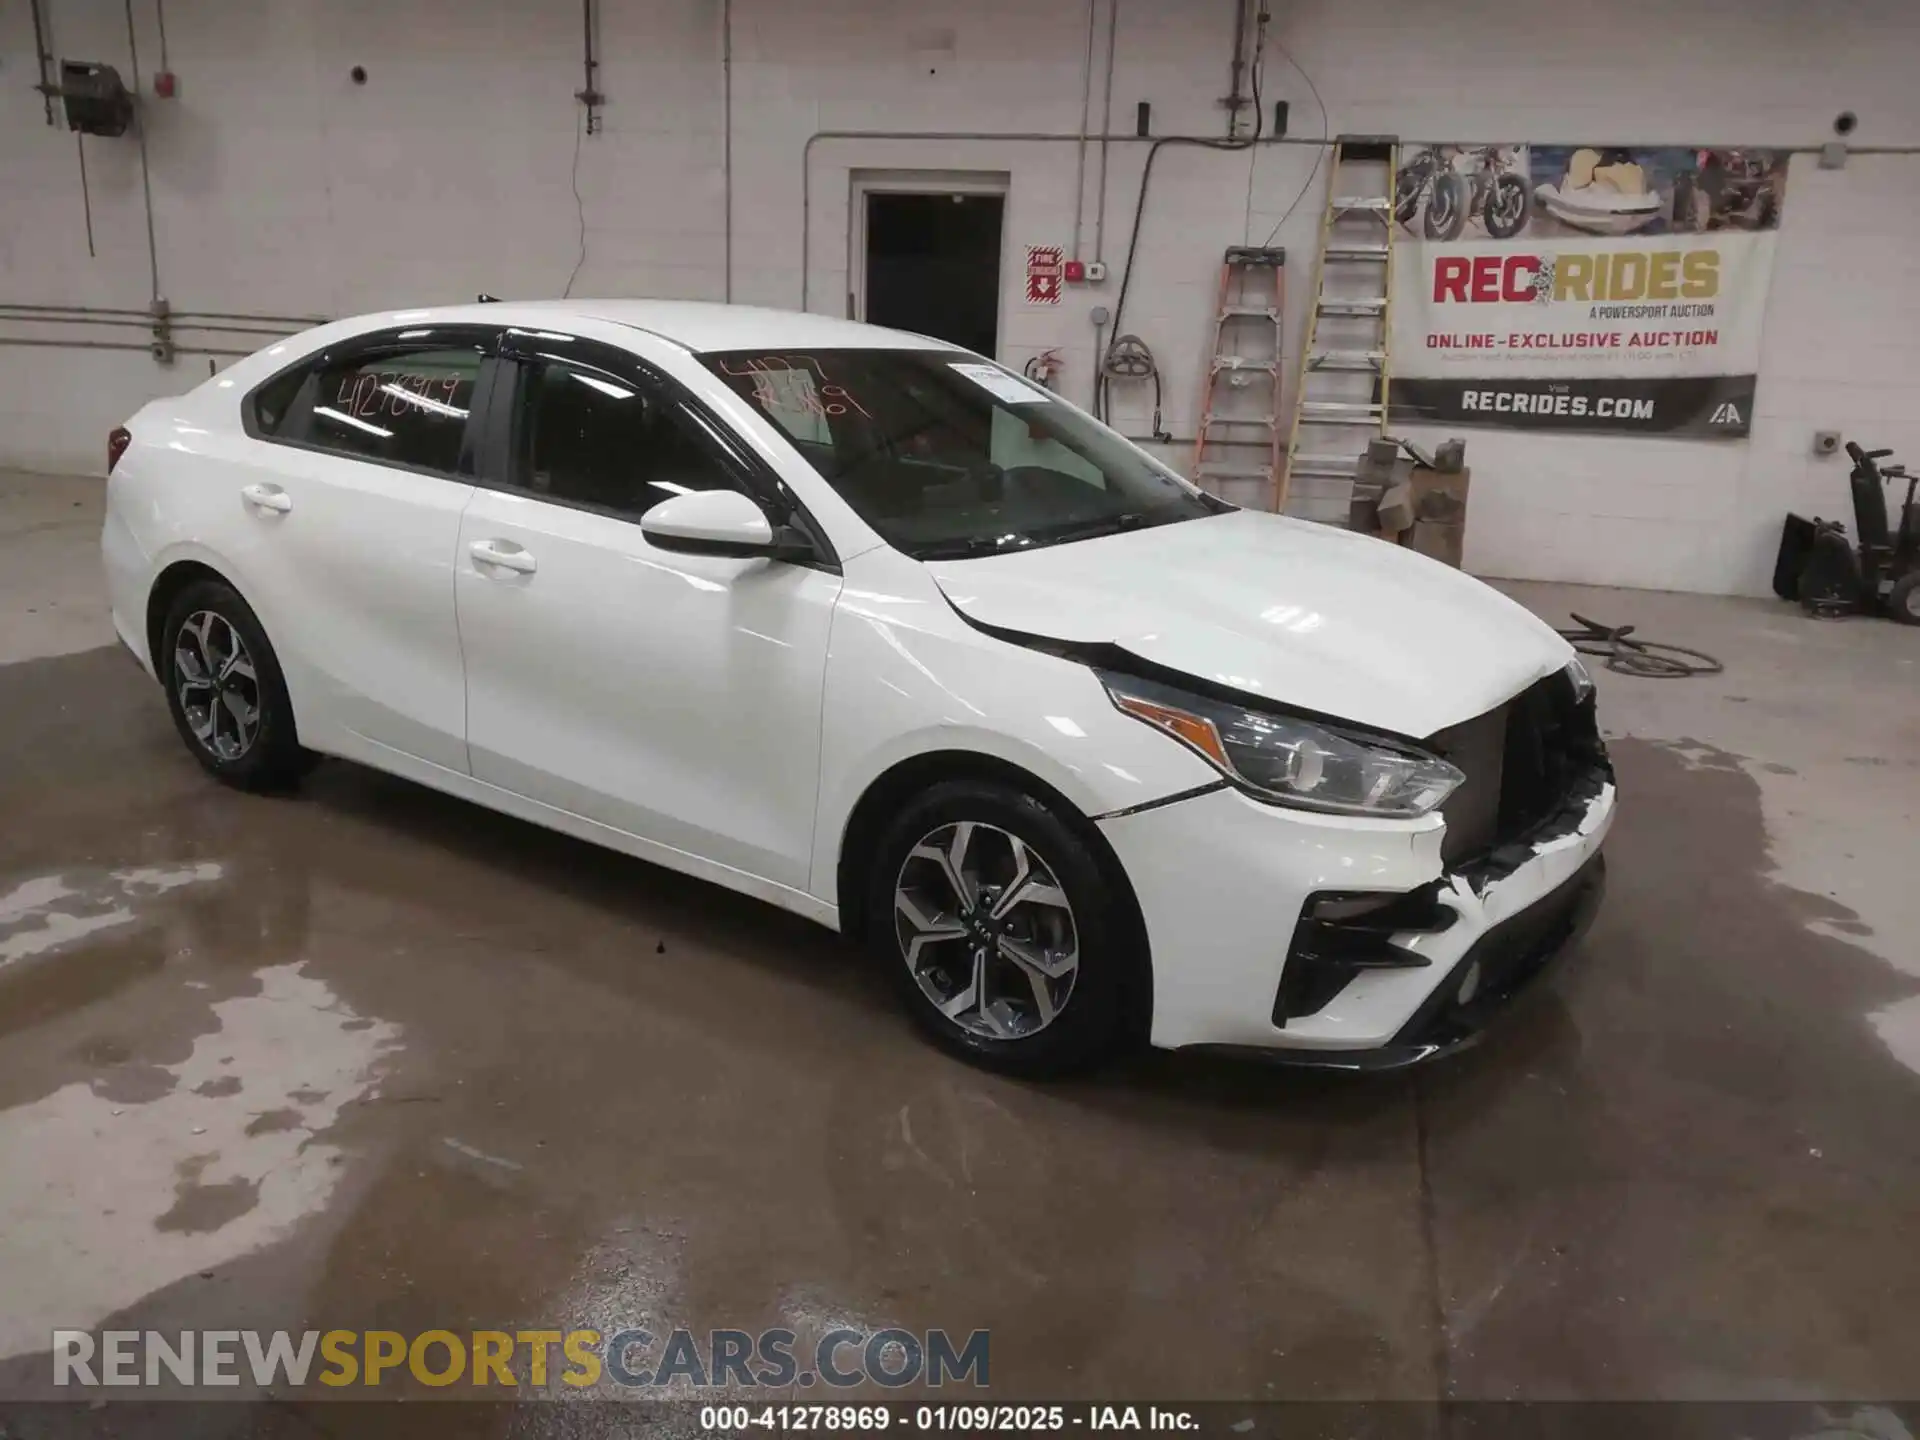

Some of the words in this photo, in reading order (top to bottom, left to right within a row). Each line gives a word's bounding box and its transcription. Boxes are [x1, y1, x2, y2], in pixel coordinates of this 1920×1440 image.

[1433, 255, 1541, 303] REC
[1553, 250, 1720, 302] RIDES
[1589, 306, 1597, 319] A
[1600, 305, 1668, 319] POWERSPORT
[1670, 304, 1714, 317] AUCTION
[1426, 332, 1621, 349] ONLINE-EXCLUSIVE
[1628, 330, 1718, 348] AUCTION
[1462, 390, 1655, 420] RECRIDES.COM
